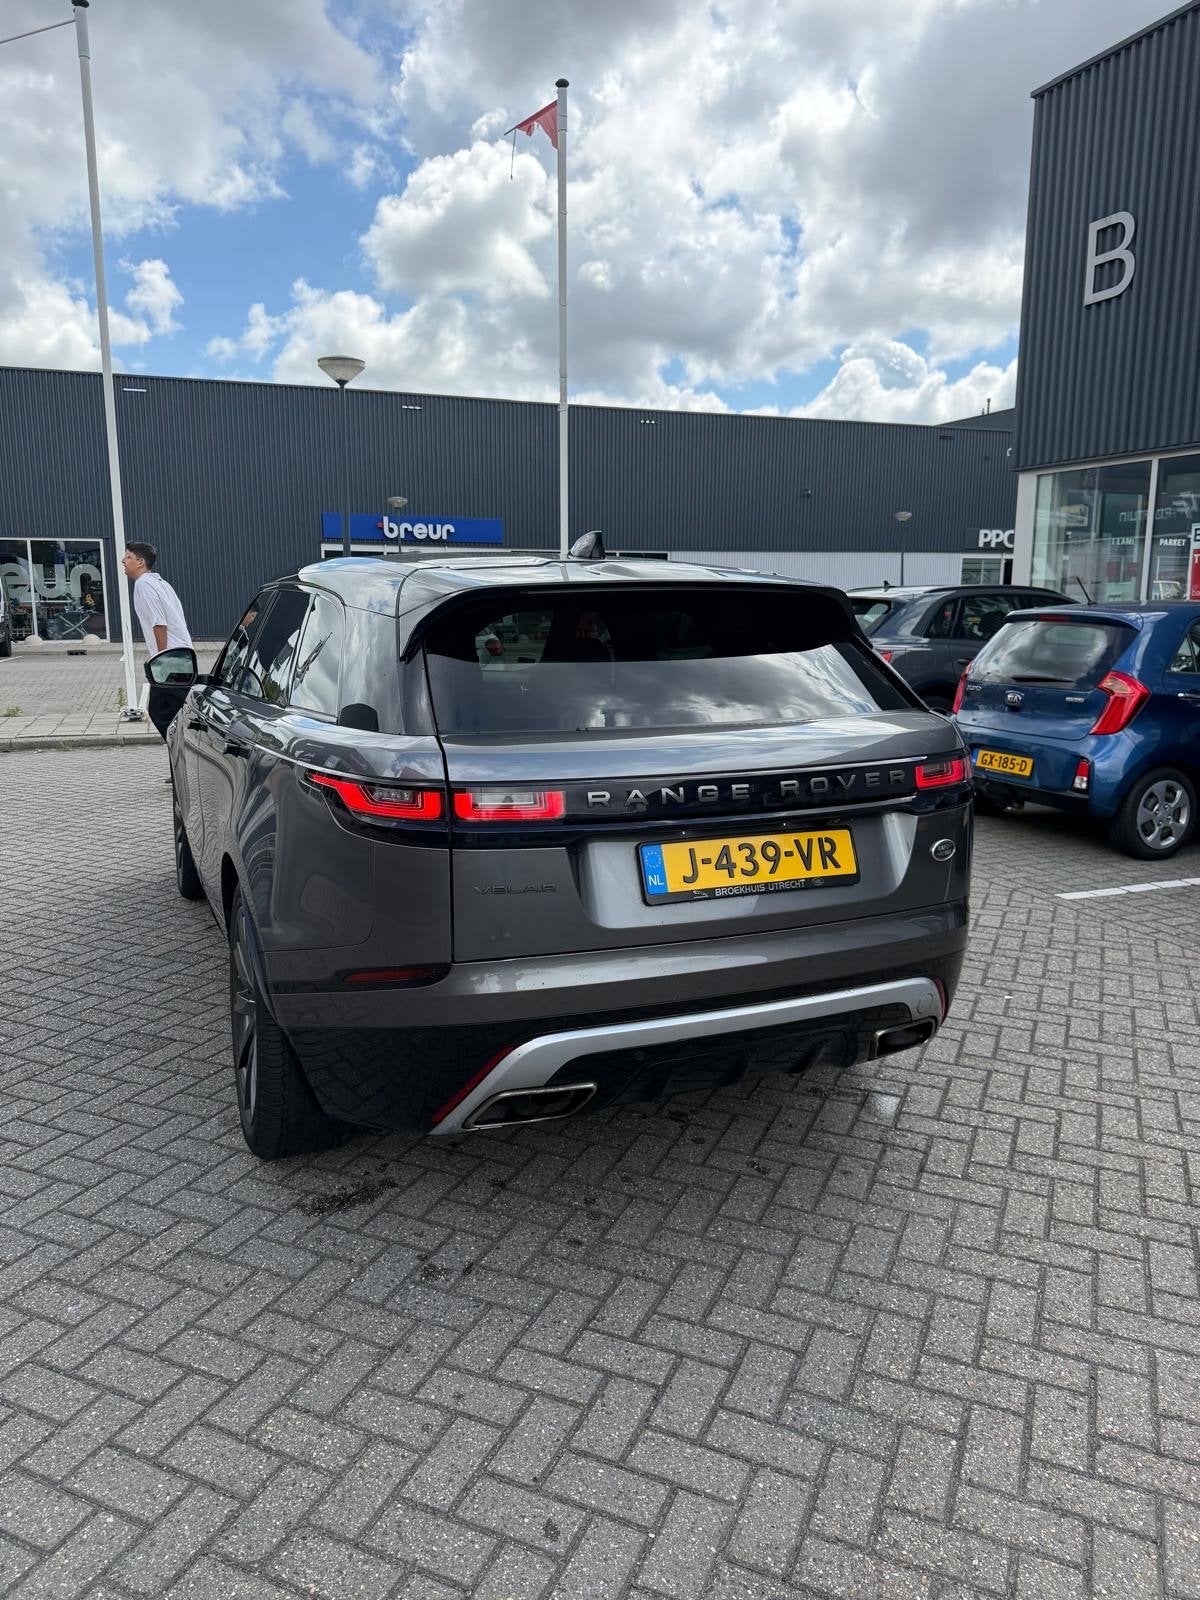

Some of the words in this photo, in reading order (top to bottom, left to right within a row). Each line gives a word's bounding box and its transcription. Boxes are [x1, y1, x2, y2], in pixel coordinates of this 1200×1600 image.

[1084, 211, 1135, 306] B
[382, 516, 455, 540] breur
[1159, 538, 1185, 546] PARKET
[981, 753, 1027, 772] GX-185-D
[587, 783, 750, 809] RANGE
[780, 769, 906, 798] ROVER
[682, 837, 841, 884] J-439-VR
[473, 883, 557, 895] VELAR
[648, 874, 664, 886] NL
[715, 883, 766, 897] BROEKHUIS
[768, 879, 806, 891] UTRECHT
